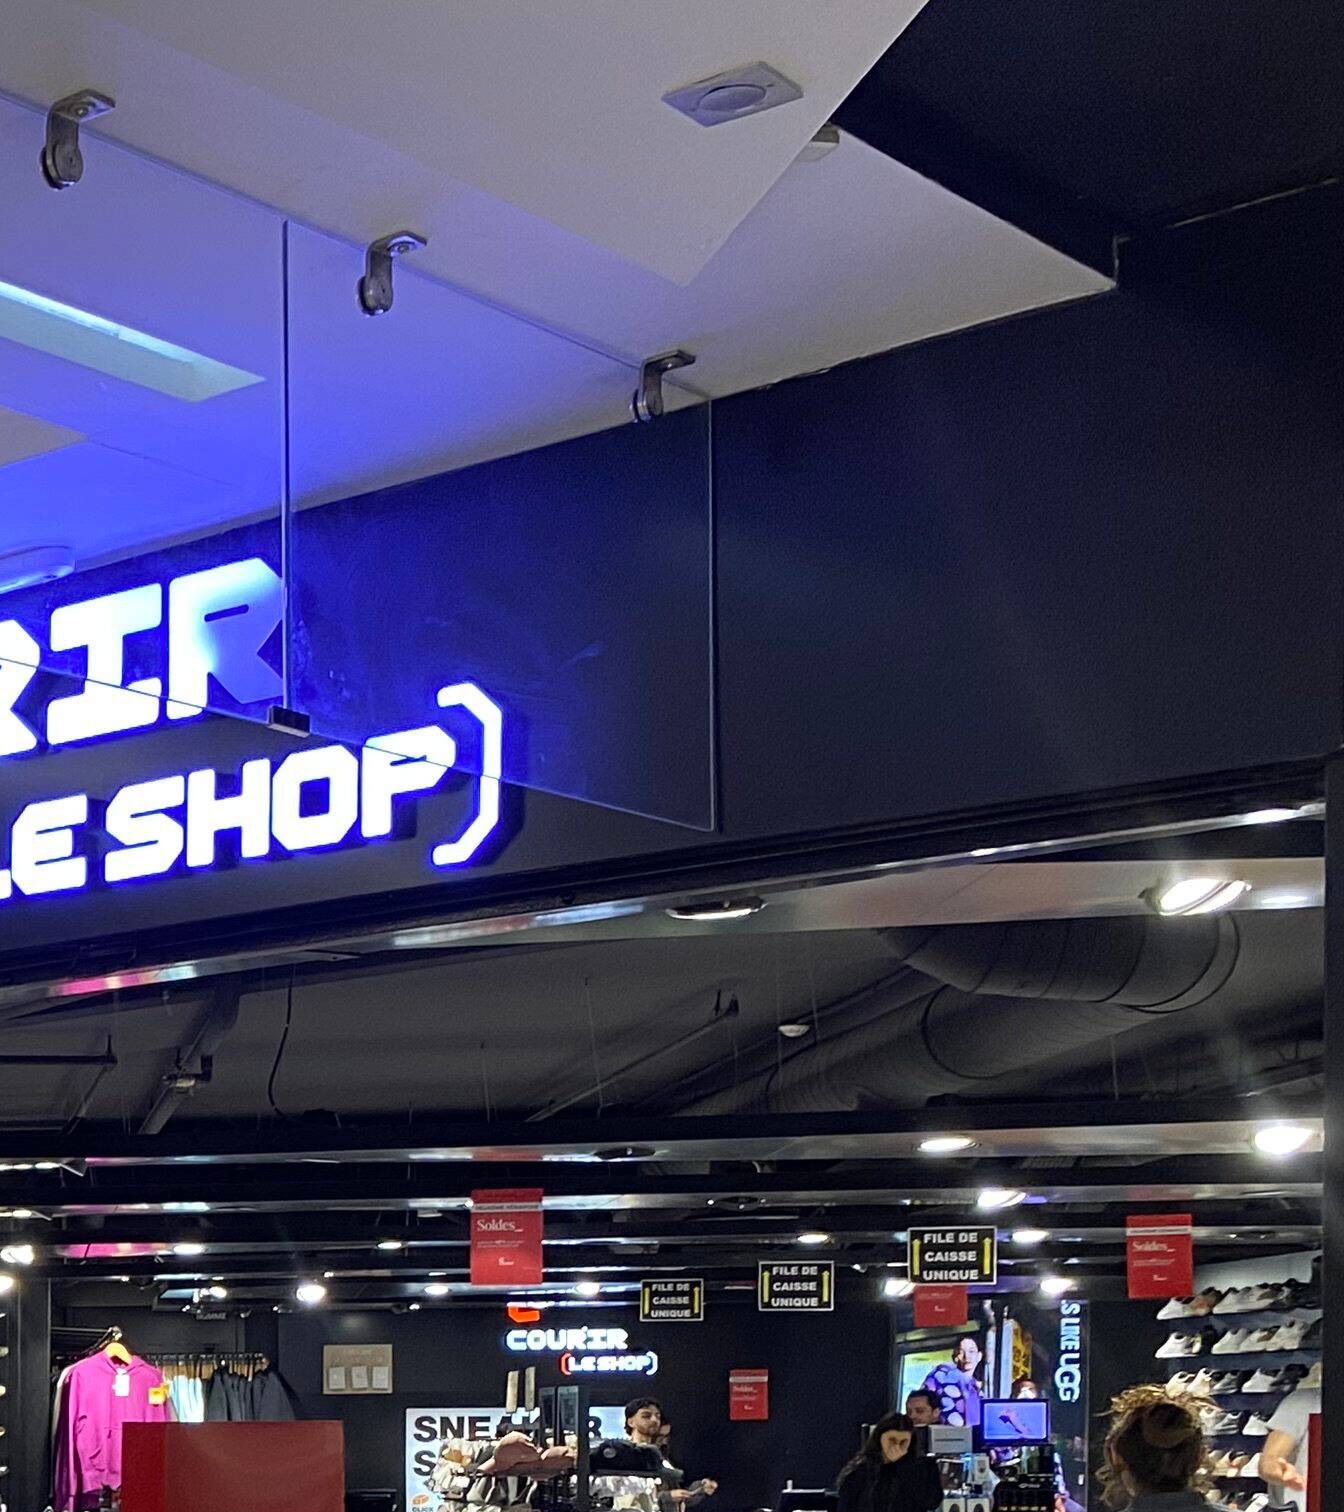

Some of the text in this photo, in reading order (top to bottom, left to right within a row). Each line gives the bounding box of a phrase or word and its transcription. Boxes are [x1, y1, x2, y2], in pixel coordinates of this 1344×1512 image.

[103, 681, 504, 883] SHOP)
[924, 1232, 978, 1244] FILE DE
[924, 1250, 977, 1262] CAISSE
[772, 1266, 818, 1275] FILE DE
[923, 1269, 979, 1281] UNIQUE
[652, 1283, 690, 1292] FILE DE
[773, 1282, 817, 1291] CAISSE
[652, 1296, 689, 1305] CAISSE
[771, 1297, 819, 1307] UNIQUE
[506, 1327, 629, 1350] COURIR
